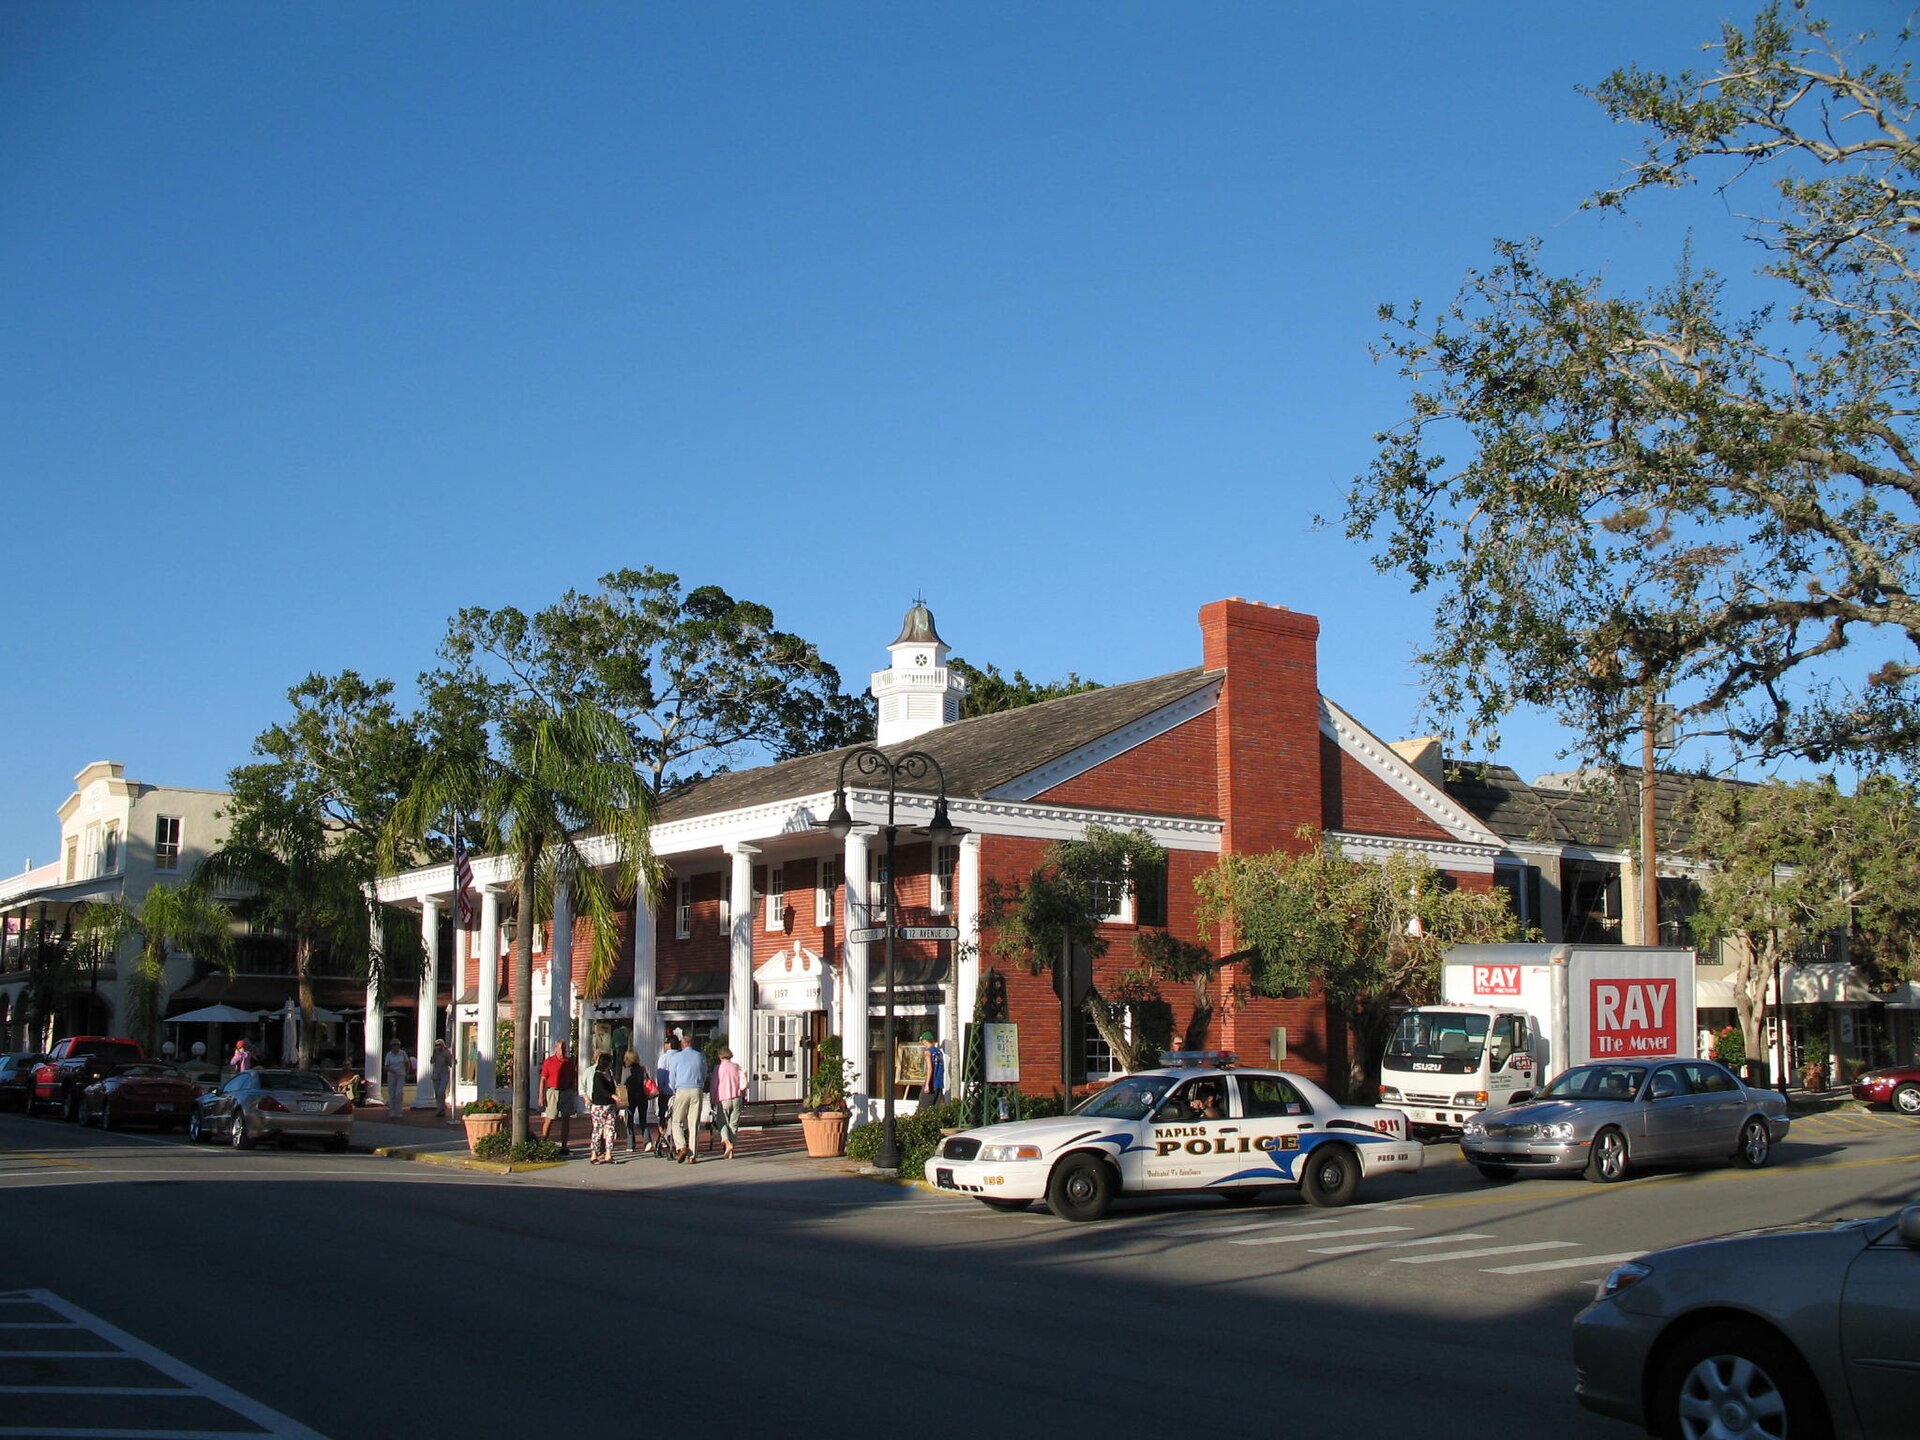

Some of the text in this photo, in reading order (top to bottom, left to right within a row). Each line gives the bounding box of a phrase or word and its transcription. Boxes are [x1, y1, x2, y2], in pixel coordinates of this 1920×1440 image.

[909, 930, 916, 938] 12
[920, 930, 942, 938] AVENUE
[1475, 967, 1519, 987] RAY
[774, 989, 788, 999] 1197
[1596, 984, 1670, 1031] RAY
[1597, 1035, 1671, 1052] The Mover
[1412, 1062, 1442, 1071] ISUZU
[1379, 1119, 1400, 1132] 911
[1155, 1127, 1207, 1139] NAPLES
[1155, 1134, 1299, 1158] POLICE
